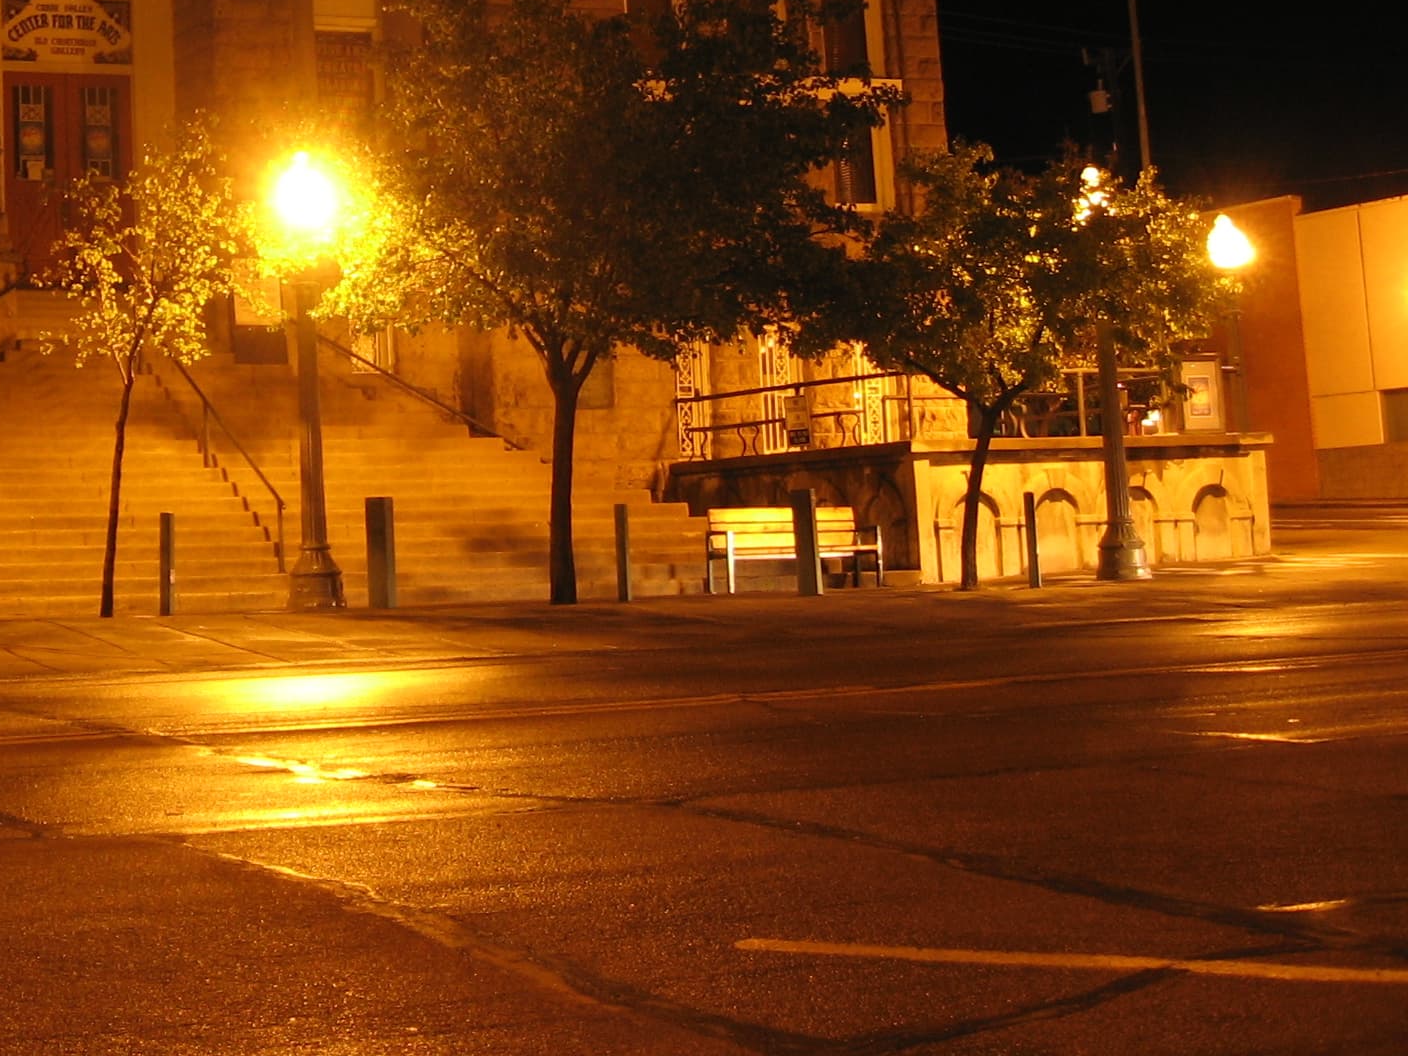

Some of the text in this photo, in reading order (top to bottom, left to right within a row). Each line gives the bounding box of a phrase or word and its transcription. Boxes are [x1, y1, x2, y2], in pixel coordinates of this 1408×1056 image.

[8, 13, 121, 45] CENTER FOR THE ARTS
